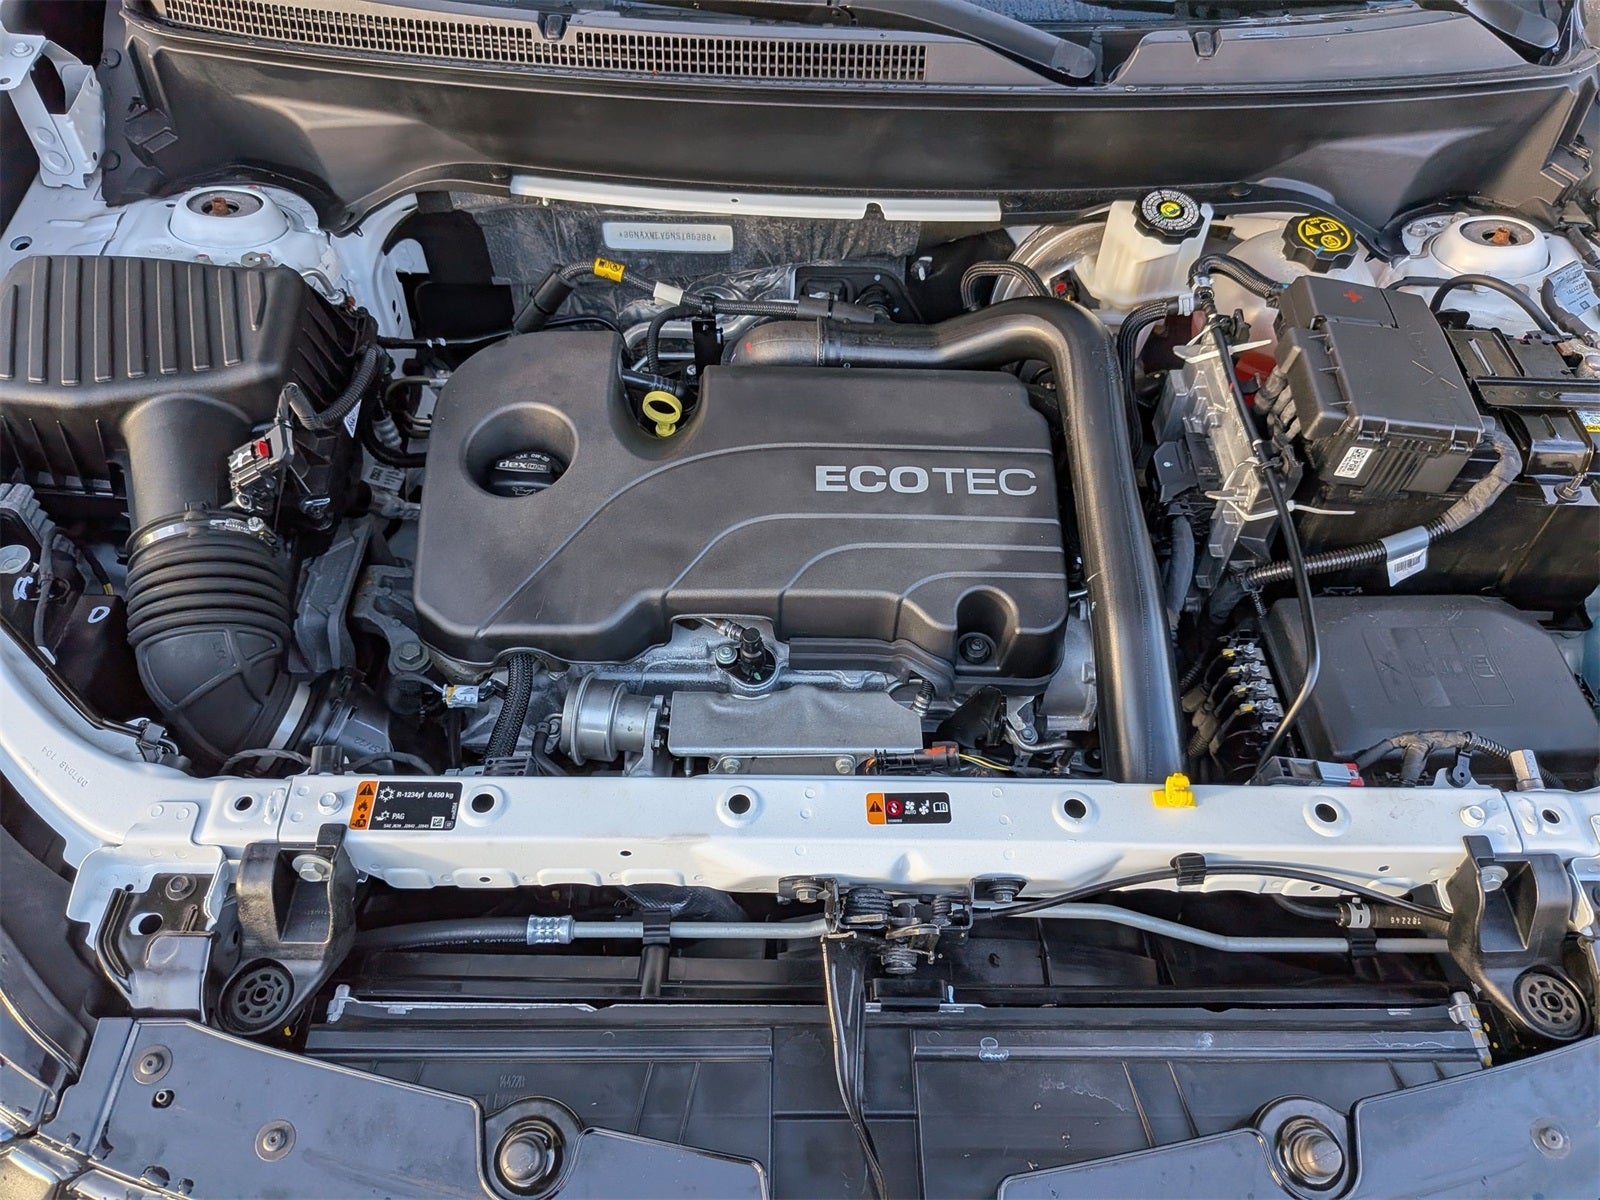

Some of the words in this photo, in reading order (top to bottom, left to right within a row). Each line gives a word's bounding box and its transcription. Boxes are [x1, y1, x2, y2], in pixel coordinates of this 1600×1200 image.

[815, 465, 1038, 496] ECOTEC
[396, 791, 425, 800] R-1234yf
[427, 791, 445, 799] 0.450
[445, 792, 454, 800] kg
[391, 812, 405, 820] PAG
